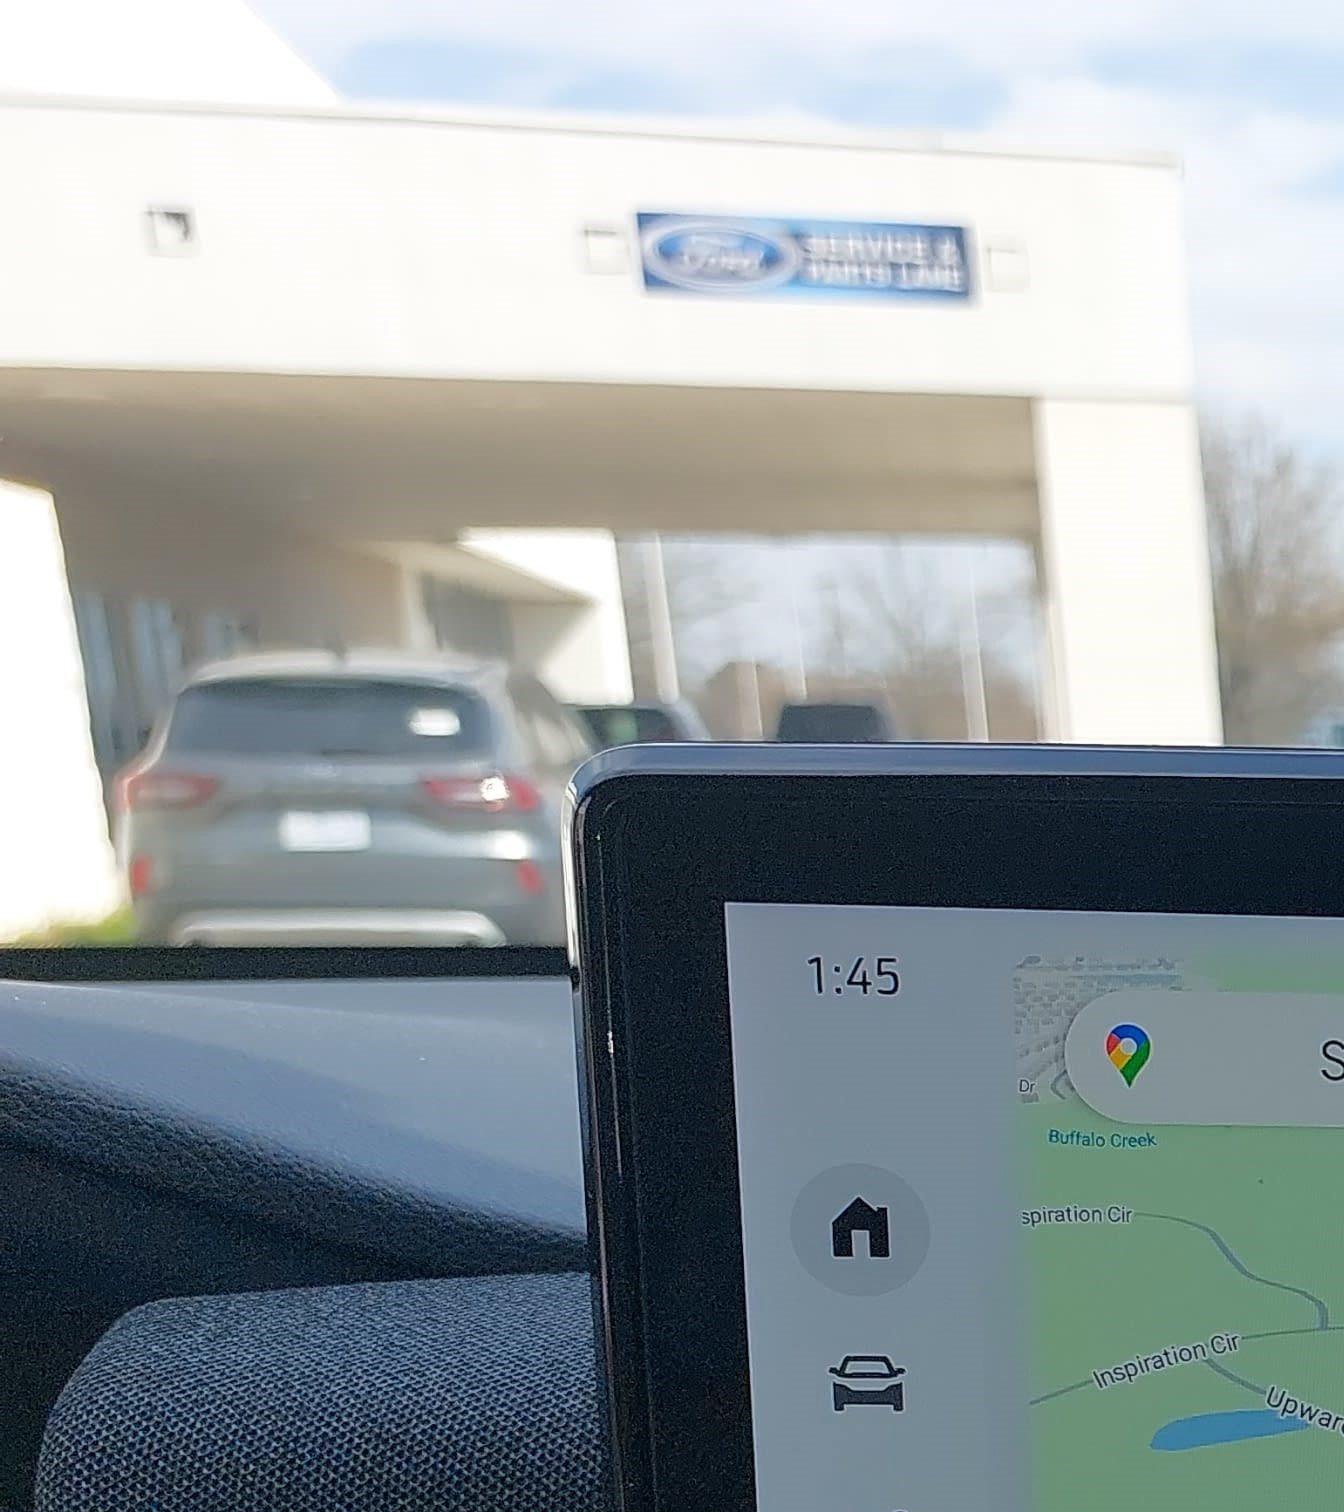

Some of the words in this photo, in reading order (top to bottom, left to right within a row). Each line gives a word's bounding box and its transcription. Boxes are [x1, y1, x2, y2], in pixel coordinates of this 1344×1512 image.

[807, 956, 900, 996] 1:45
[1018, 1079, 1036, 1093] Dr
[1048, 1128, 1106, 1148] Buffalo
[1110, 1132, 1157, 1148] Creek
[1107, 1205, 1133, 1223] Cir
[1093, 1343, 1207, 1390] Inspiration
[1209, 1333, 1241, 1355] Cir
